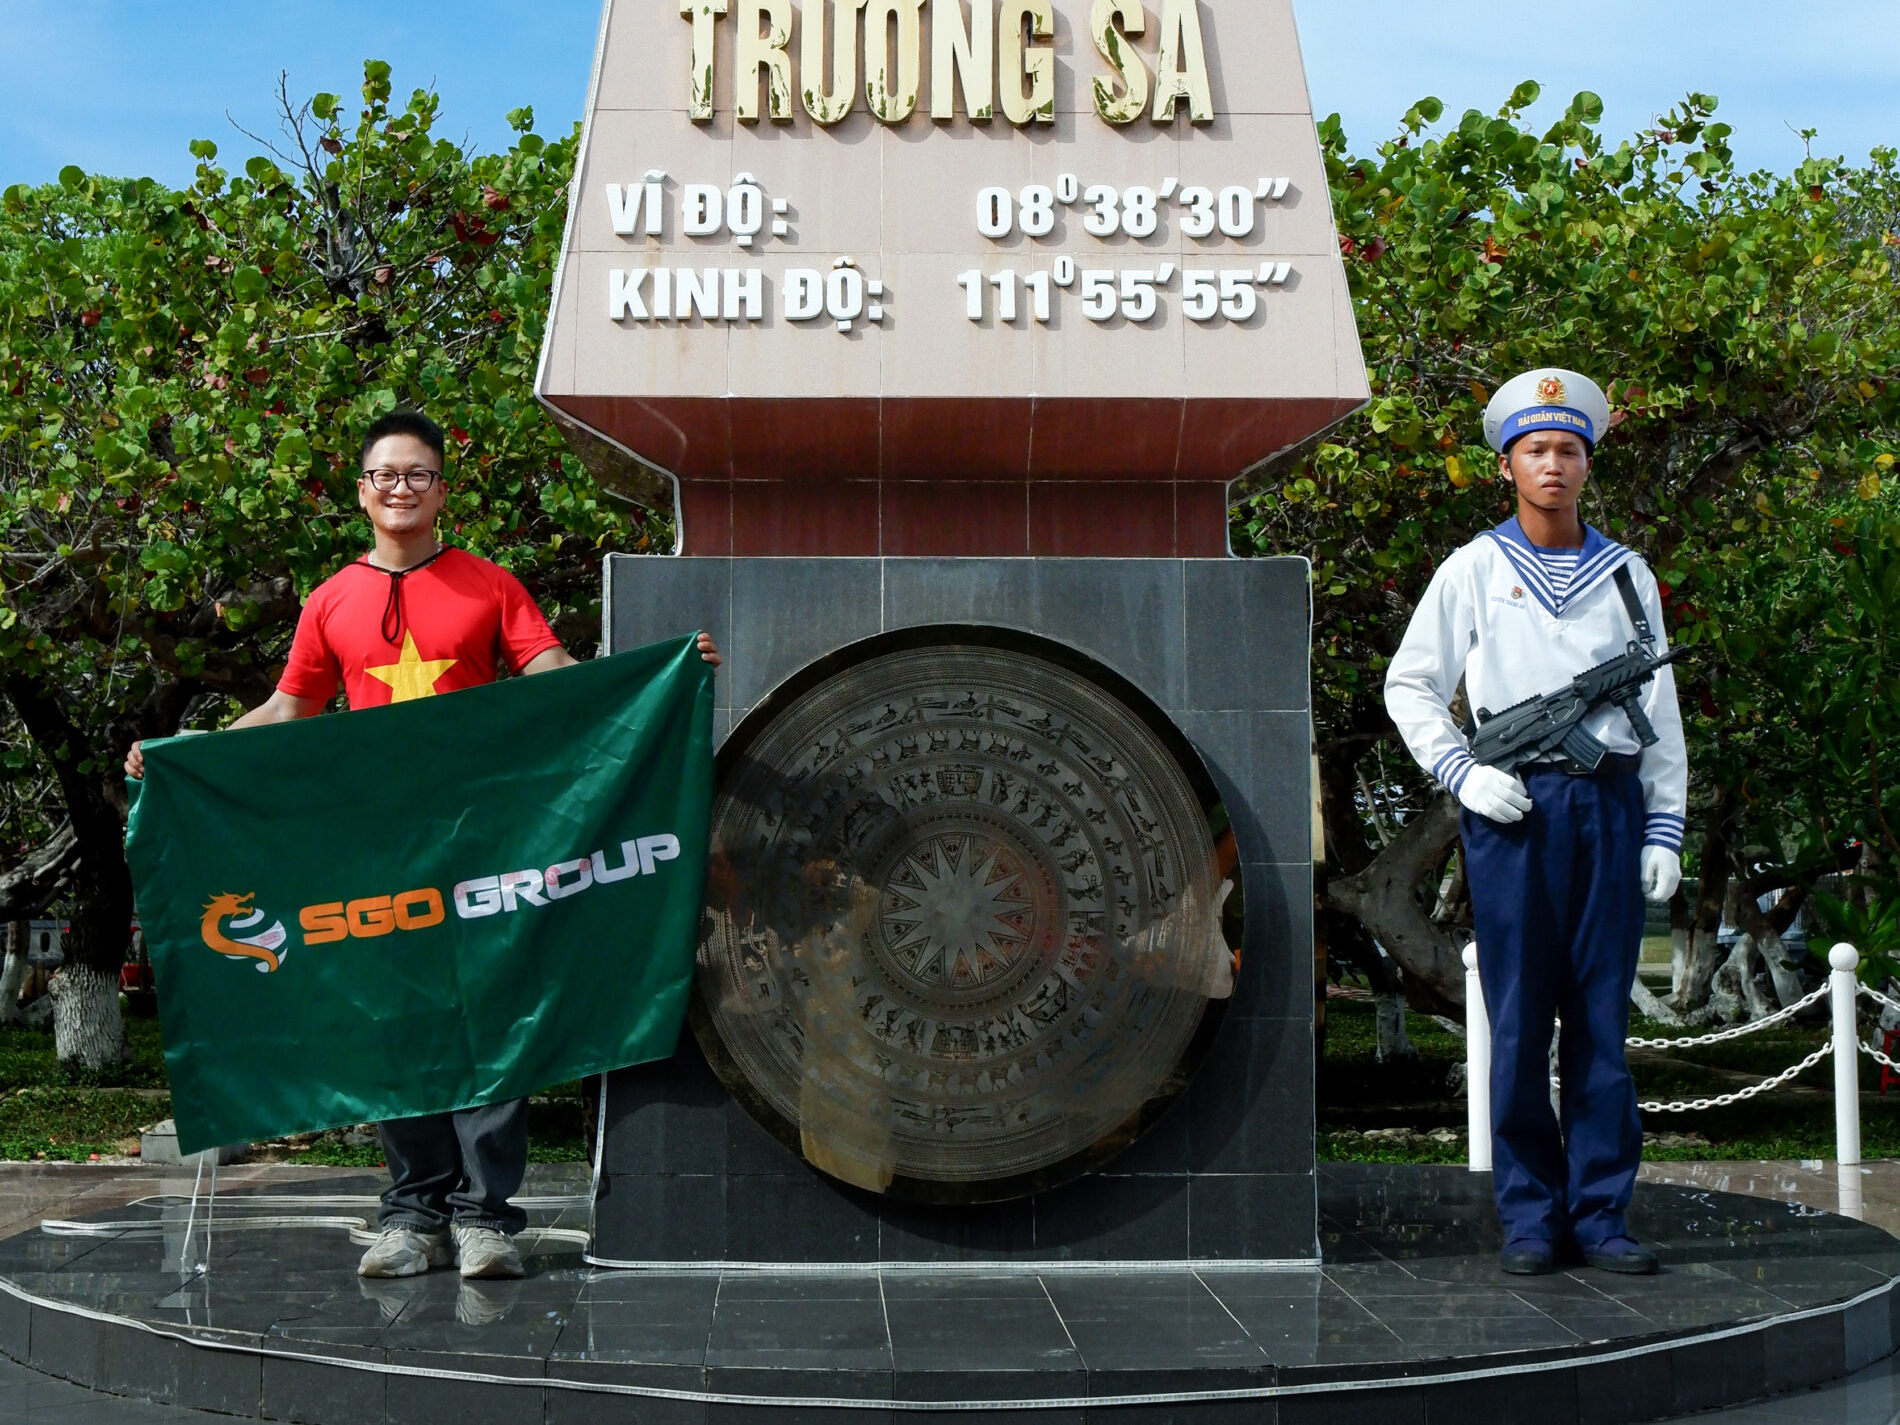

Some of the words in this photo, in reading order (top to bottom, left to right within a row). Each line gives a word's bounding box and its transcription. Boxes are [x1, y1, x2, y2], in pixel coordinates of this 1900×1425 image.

[605, 169, 667, 236] VĨ
[681, 172, 788, 247] ĐỘ:
[609, 267, 763, 320] KINH
[782, 255, 884, 333] ĐỘ:
[1518, 413, 1530, 427] HẢI
[1530, 410, 1554, 424] QUÂN
[1553, 411, 1572, 425] VIỆT
[1572, 415, 1587, 429] NAM
[300, 887, 446, 946] SGO
[453, 833, 681, 920] GROUP
